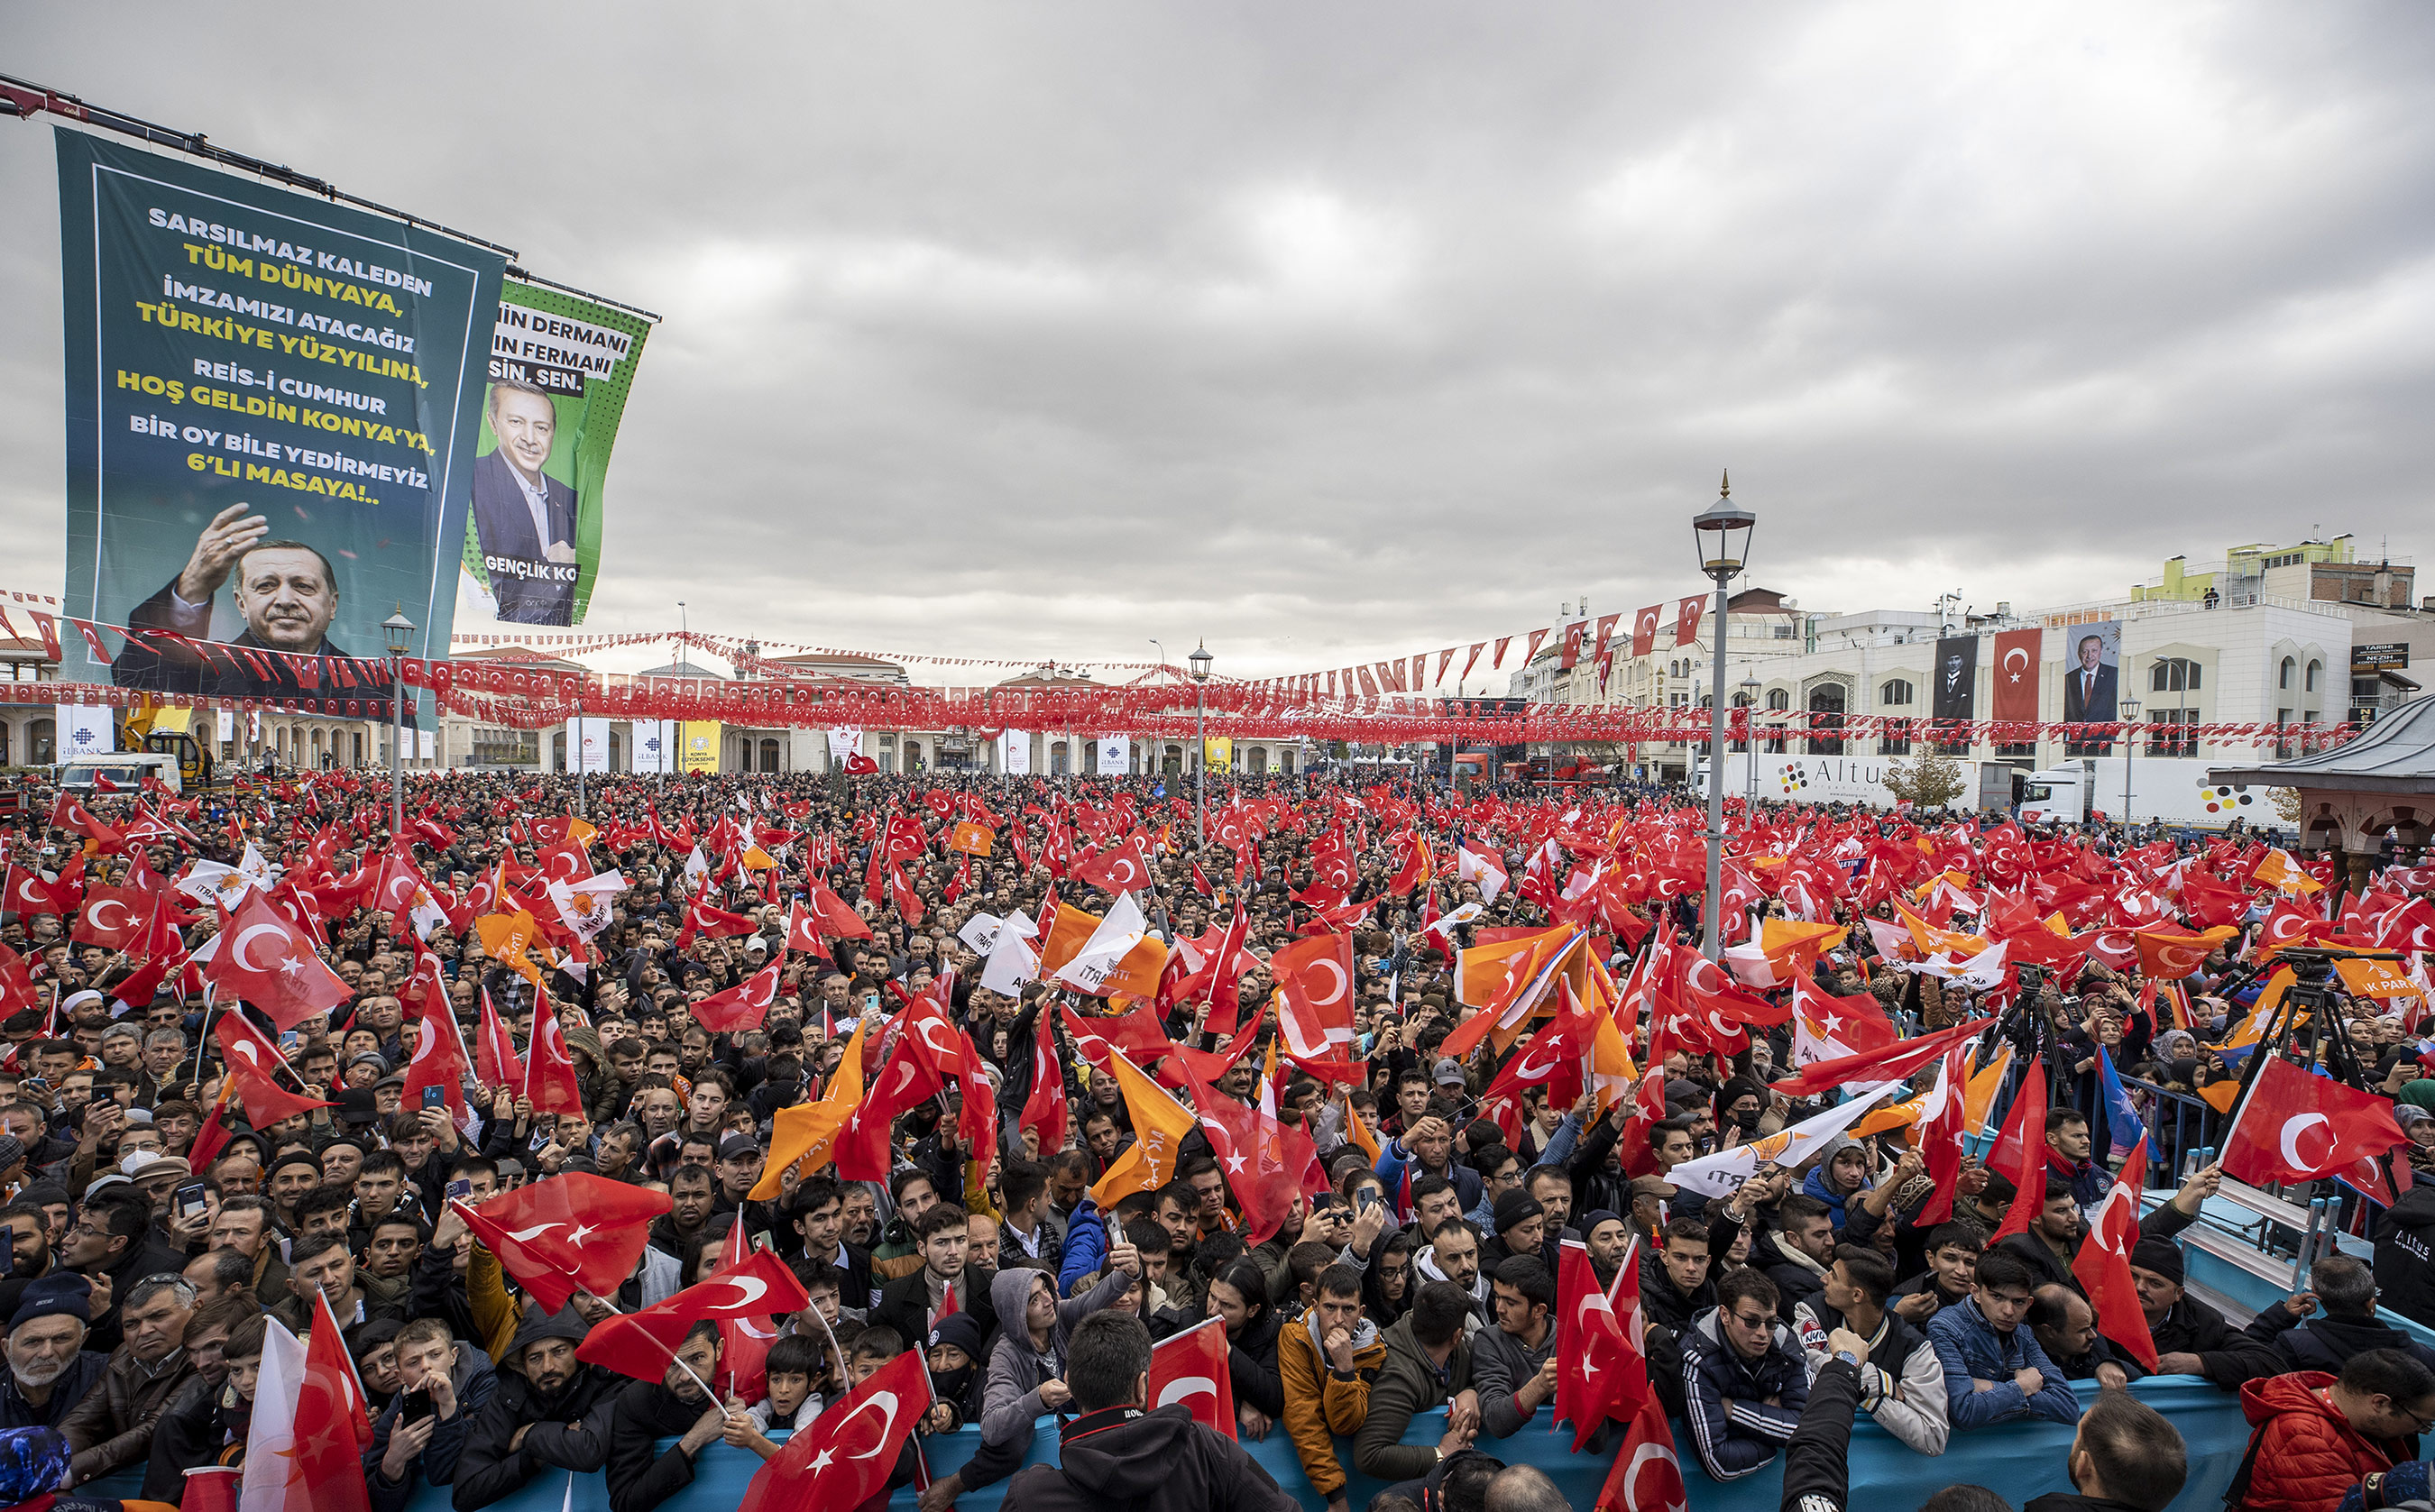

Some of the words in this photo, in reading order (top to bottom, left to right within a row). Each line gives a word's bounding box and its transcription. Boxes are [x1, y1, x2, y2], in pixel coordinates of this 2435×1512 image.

[149, 207, 313, 266] SARSILMAZ
[317, 251, 433, 298] KALEDEN
[183, 243, 253, 279] TÜM
[260, 261, 404, 318] DÜNYAYA,
[163, 273, 294, 325] İMZAMIZI
[297, 311, 415, 354] ATACAĞIZ
[135, 300, 274, 351] TÜRKİYE
[278, 333, 429, 389] YÜZYILINA,
[531, 316, 629, 354] DERMANI
[194, 358, 274, 391] REİS-İ
[279, 378, 387, 416] CUMHUR
[536, 369, 583, 391] SEN.
[117, 369, 185, 405] HOŞ
[190, 385, 297, 424] GELDİN
[302, 408, 436, 457] KONYA'YA,
[130, 414, 179, 440] BİR
[182, 426, 222, 447] OY
[225, 432, 281, 460] BİLE
[284, 444, 428, 490] YEDİRMEYİZ
[187, 453, 241, 478] 6'LI
[484, 555, 551, 581] GENÇLİK
[1815, 759, 1899, 783] Altus
[577, 920, 593, 935] AK
[593, 903, 610, 927] PARTİ
[1888, 959, 1904, 968] AK
[2395, 1230, 2430, 1256] Altus
